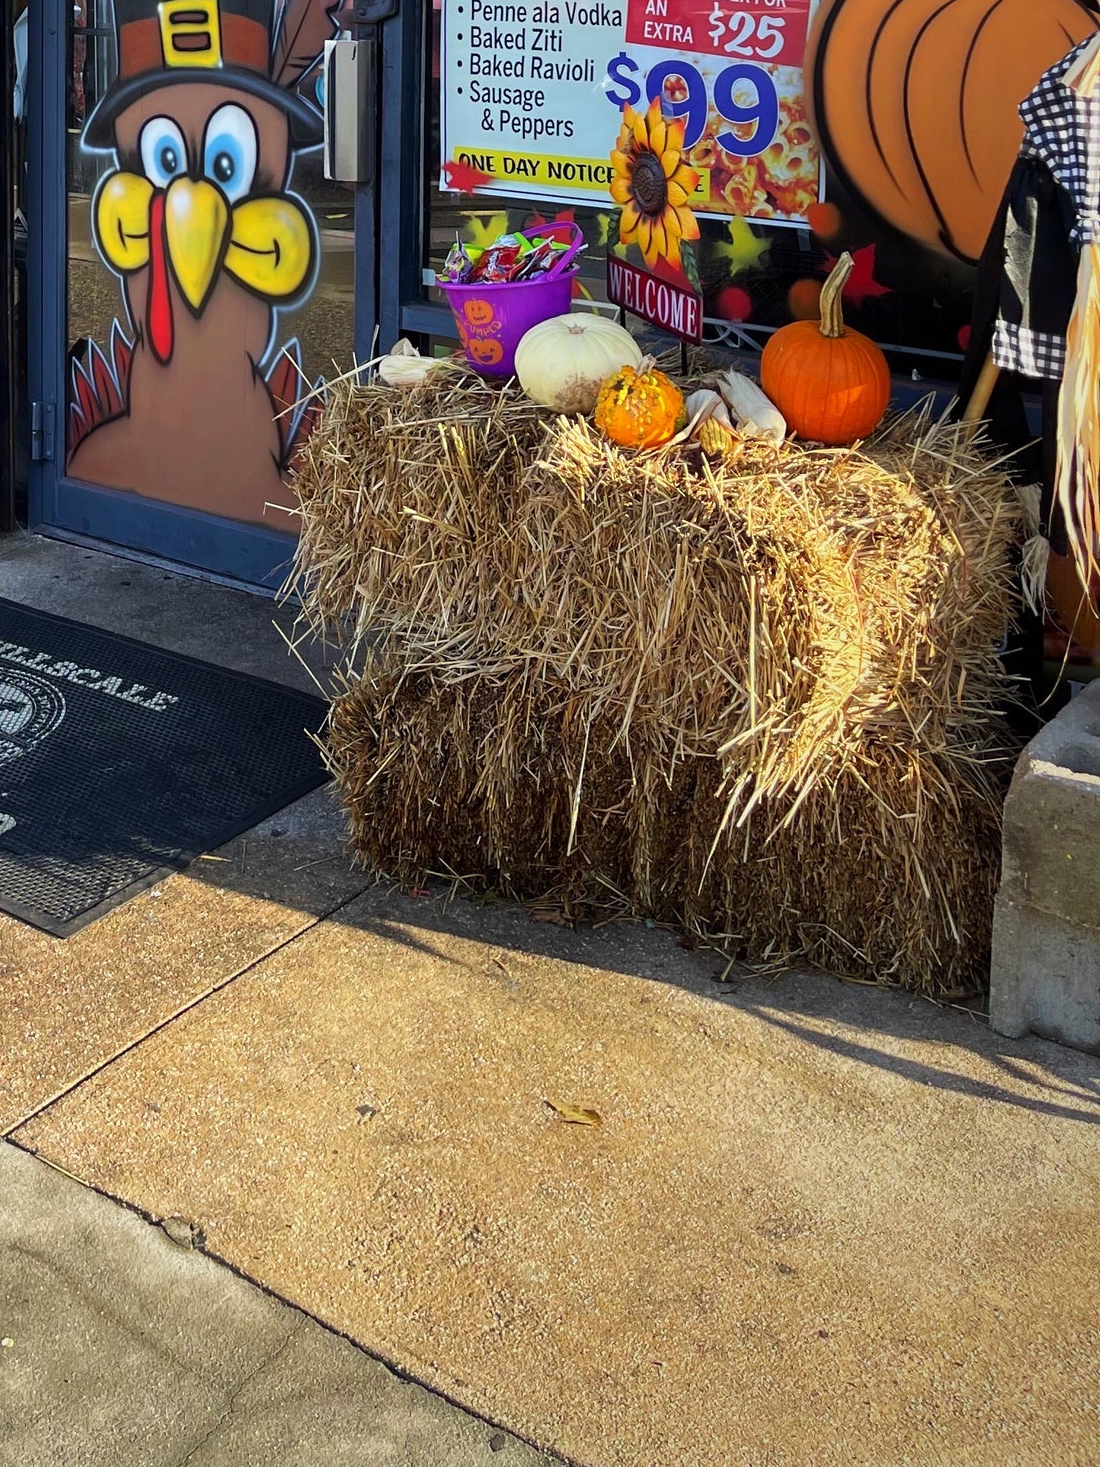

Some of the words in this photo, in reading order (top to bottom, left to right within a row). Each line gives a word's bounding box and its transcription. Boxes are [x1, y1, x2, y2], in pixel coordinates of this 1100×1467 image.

[532, 1, 560, 23] ala
[564, 1, 622, 28] Vodka
[469, 25, 526, 51] Baked
[531, 28, 563, 53] Ziti
[643, 21, 694, 44] EXTRA
[707, 2, 786, 59] $25
[469, 53, 525, 78] Baked
[530, 55, 595, 83] Ravioli
[469, 80, 545, 111] Sausage
[605, 51, 779, 158] $99
[480, 108, 495, 132] &
[499, 110, 574, 140] Peppers
[457, 152, 496, 173] ONE
[503, 156, 540, 177] DAY
[608, 262, 698, 337] WELCOME
